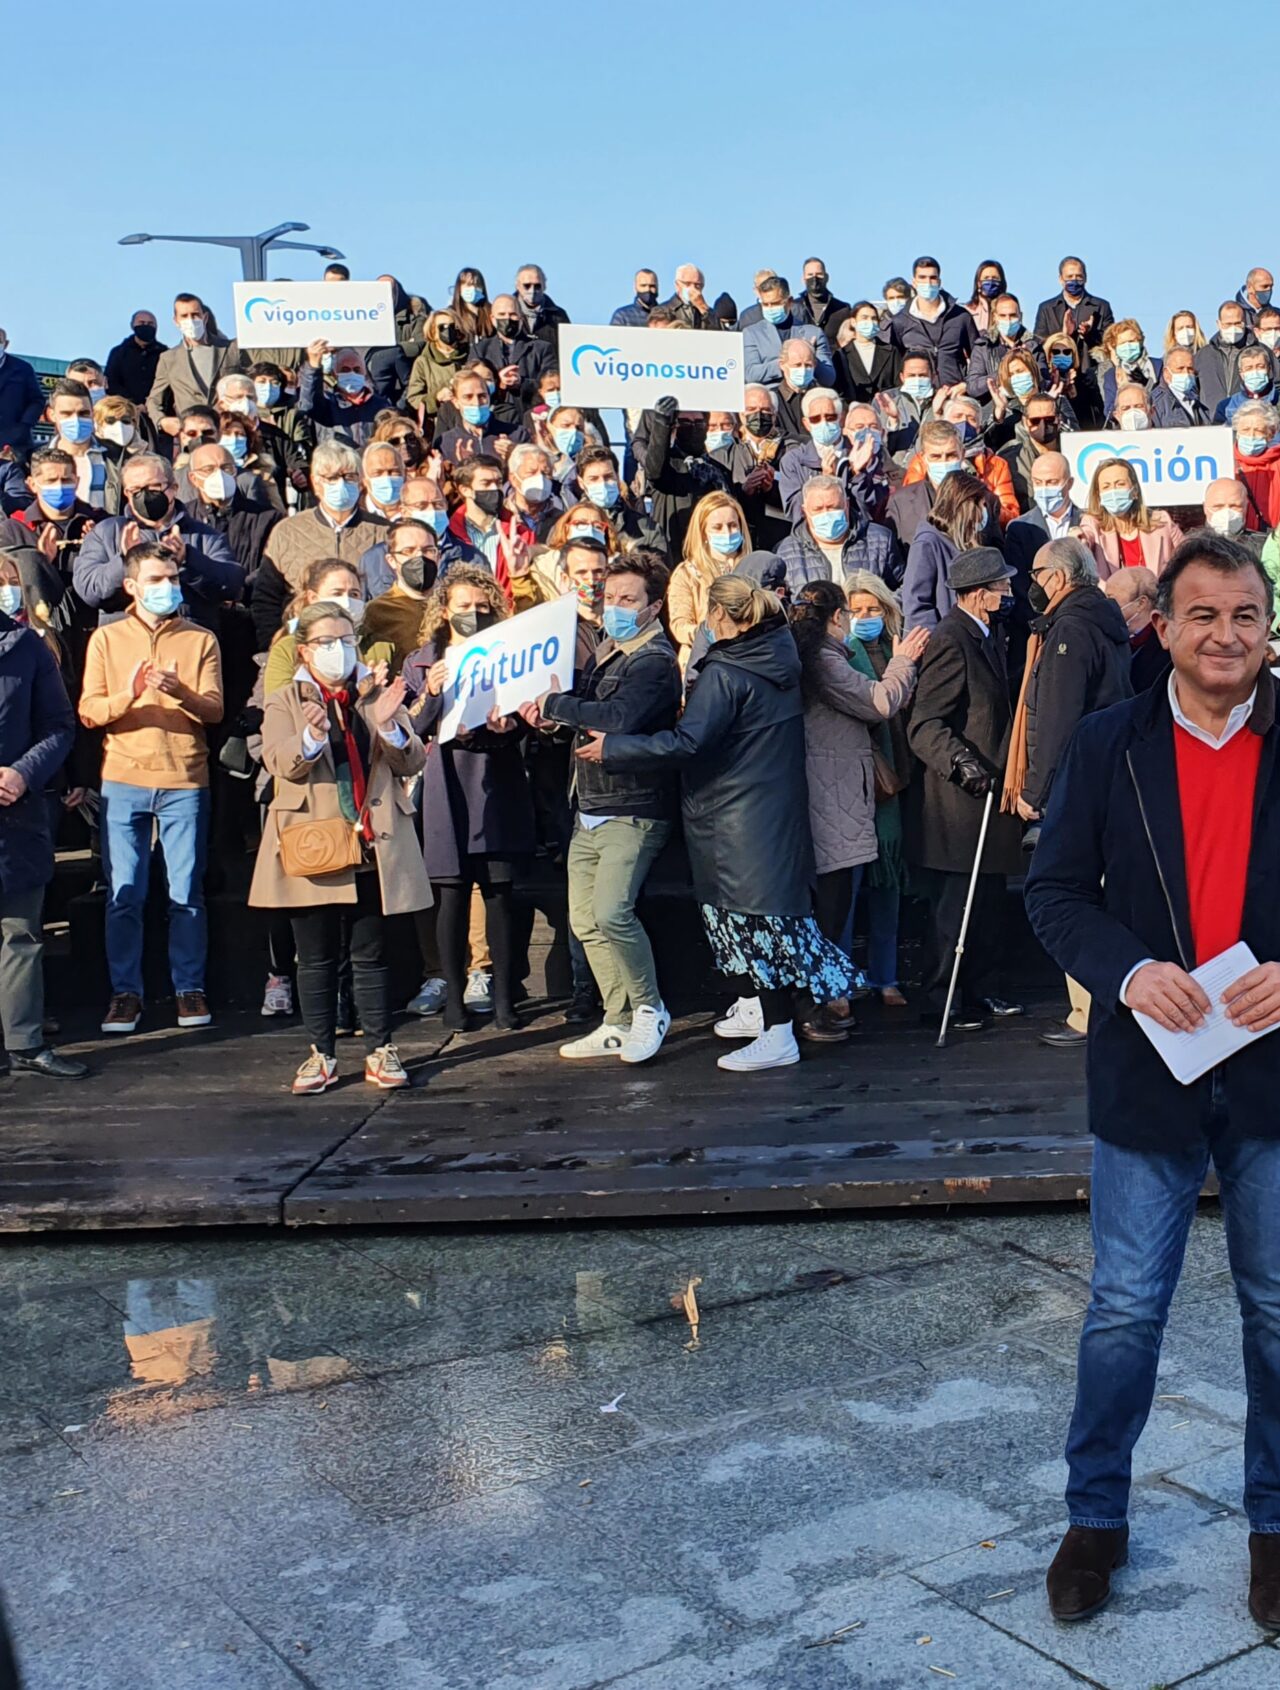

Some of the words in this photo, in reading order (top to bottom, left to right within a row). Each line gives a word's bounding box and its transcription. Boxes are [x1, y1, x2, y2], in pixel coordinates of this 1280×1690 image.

[264, 306, 379, 326] vigonosune
[594, 356, 728, 381] vigonosune
[1126, 445, 1218, 483] nión
[470, 636, 560, 698] futuro
